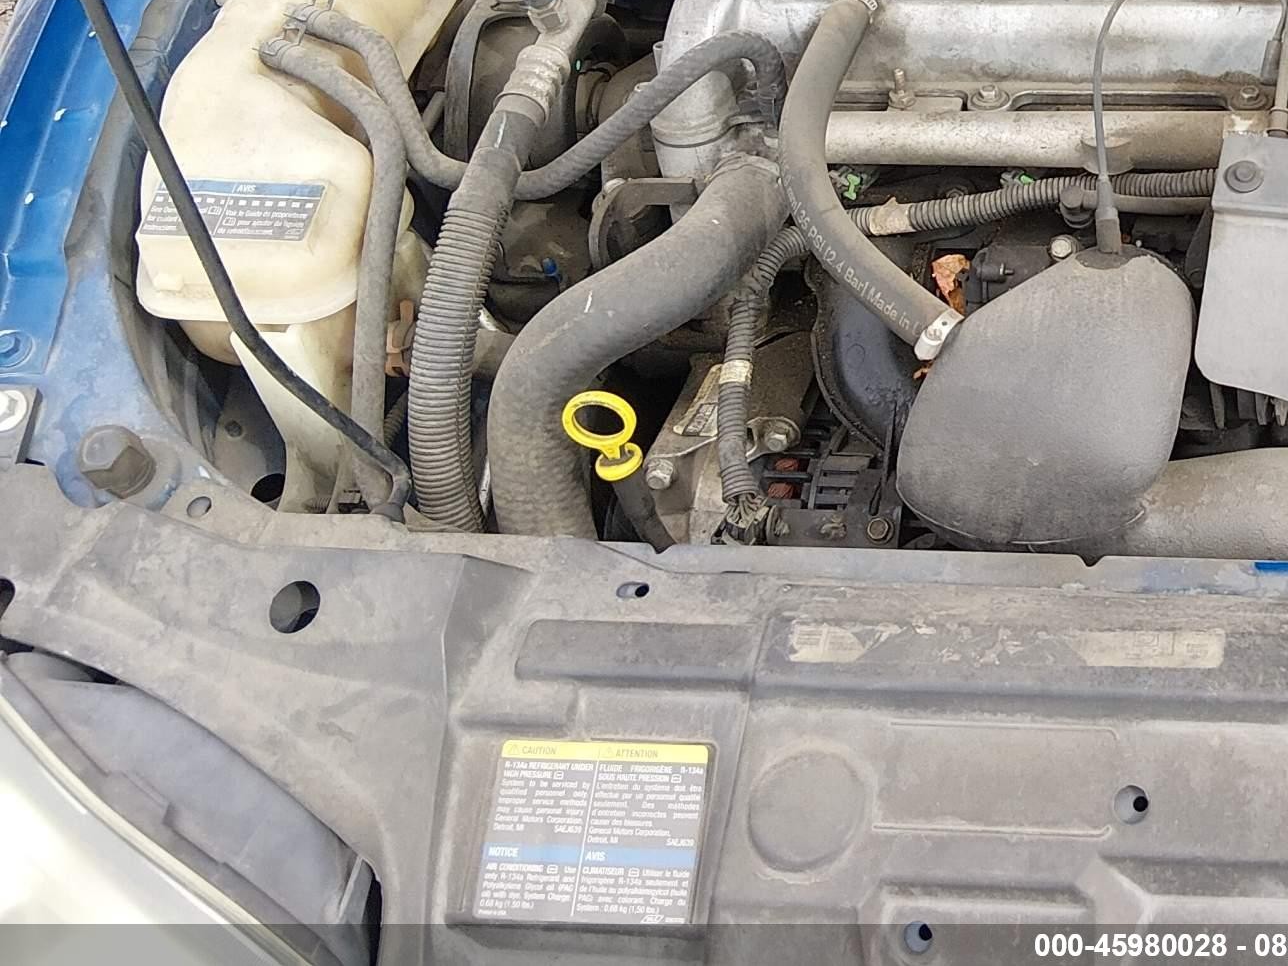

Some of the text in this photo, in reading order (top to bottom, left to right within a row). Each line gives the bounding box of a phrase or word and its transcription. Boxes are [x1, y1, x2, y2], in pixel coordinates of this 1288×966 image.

[798, 211, 810, 230] 35
[808, 227, 826, 251] PSI
[867, 287, 898, 319] Made
[898, 312, 911, 329] in
[522, 746, 556, 755] CAUTION
[616, 749, 658, 758] ATTENTION
[504, 761, 594, 771] R-134a REFRIGERANT UNDER
[599, 764, 623, 772] FLUIDE
[519, 771, 552, 779] PRESSURE
[598, 773, 669, 782] SOUS HAUTE PRESSION
[494, 814, 519, 822] General
[589, 826, 612, 834] General
[613, 827, 634, 835] Motors
[488, 847, 519, 857] NOTICE
[585, 851, 606, 861] AVIS
[499, 863, 544, 872] CONDITIONING
[582, 867, 624, 876] CLIMATISEUR
[500, 873, 524, 881] R-134a
[618, 878, 642, 886] R-134a
